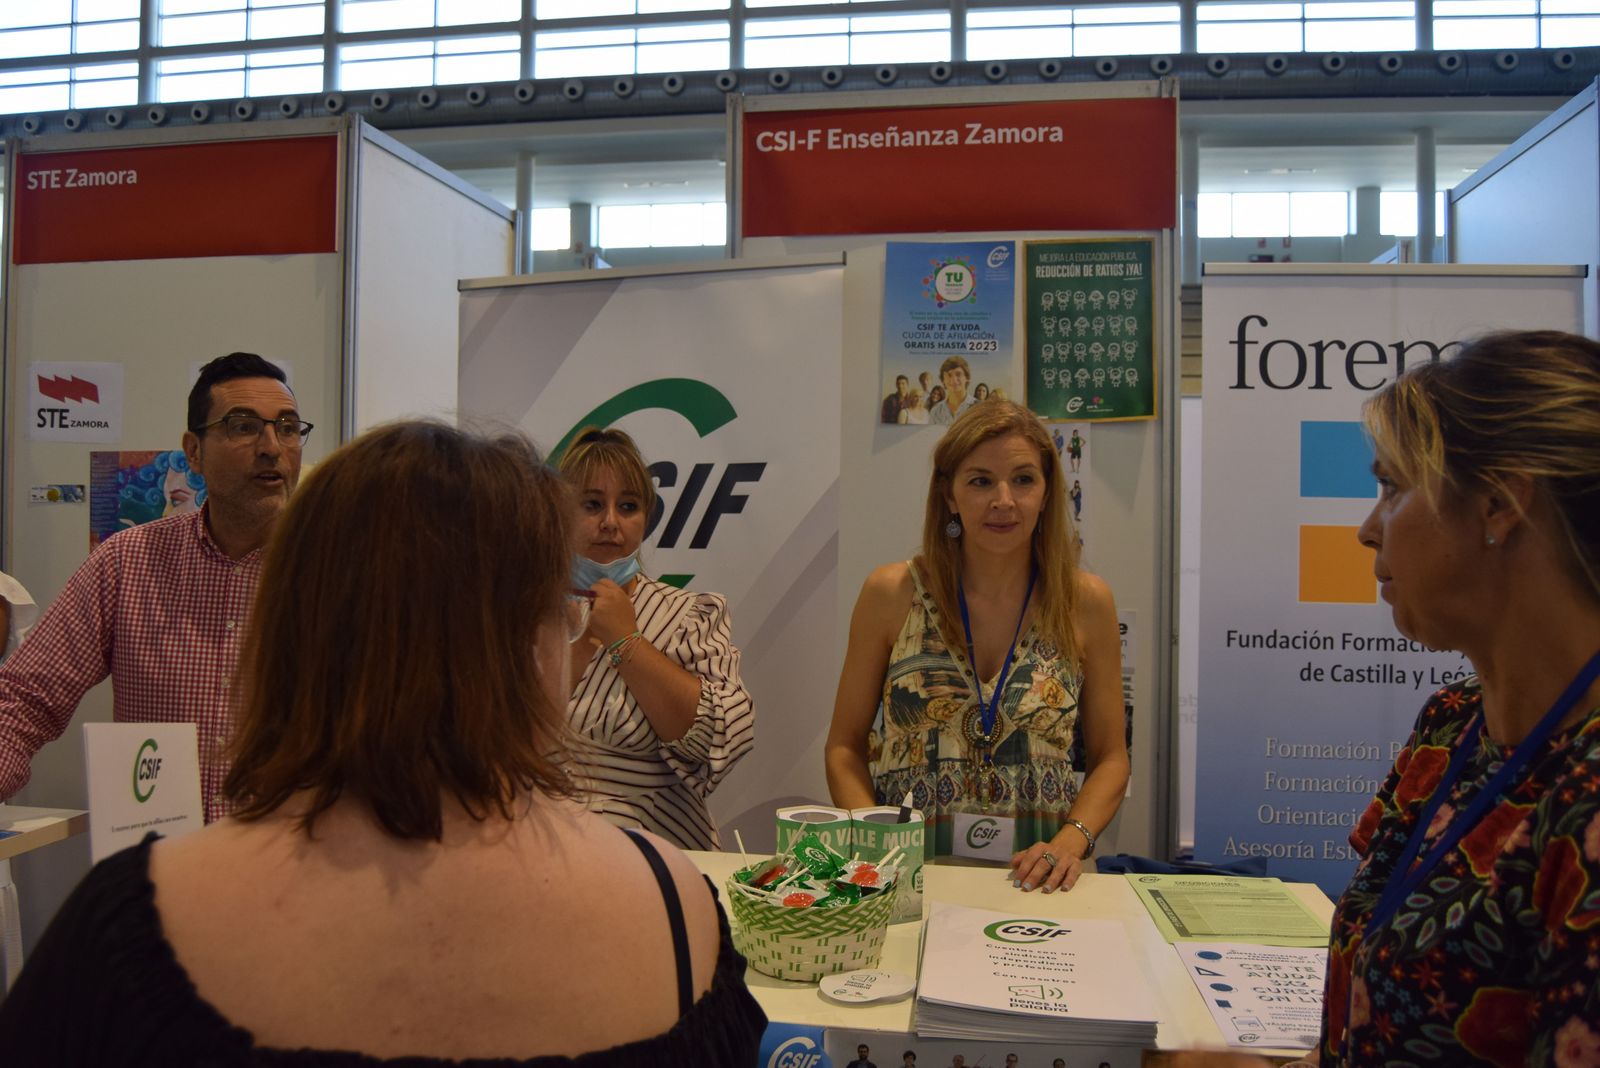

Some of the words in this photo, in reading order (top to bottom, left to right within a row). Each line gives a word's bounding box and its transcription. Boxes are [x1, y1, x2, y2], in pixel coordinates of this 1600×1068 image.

[756, 129, 821, 152] CSI-F
[828, 125, 959, 150] Enseñanza
[965, 122, 1063, 145] Zamora
[27, 170, 61, 190] STE
[65, 168, 137, 188] Zamora
[945, 272, 963, 282] TU
[1036, 263, 1081, 278] REDUCCIÓN
[1083, 265, 1093, 277] DE
[1095, 263, 1124, 277] RATIOS
[917, 323, 934, 331] CSIF
[938, 323, 947, 331] TE
[950, 323, 980, 331] AYUDA
[902, 332, 931, 340] CUOTA
[934, 332, 944, 340] DE
[947, 331, 995, 340] AFILIACIÓN
[904, 341, 935, 350] GRATIS
[938, 341, 966, 350] HASTA
[968, 341, 997, 351] 2023
[37, 408, 70, 428] STE
[71, 420, 109, 429] ZAMORA
[1227, 629, 1334, 650] Fundación
[1300, 662, 1324, 682] de
[1331, 664, 1406, 684] Castilla
[1413, 671, 1424, 690] y
[1265, 737, 1381, 760] Formación
[139, 758, 162, 780] CSIF
[1264, 771, 1379, 793] Formación
[1258, 804, 1361, 827] Orientaci
[836, 827, 876, 848] VALE
[973, 827, 1001, 841] CSIF
[1223, 836, 1315, 859] Asesoría
[1002, 925, 1072, 938] CSIF
[1005, 952, 1057, 960] sindicato
[1003, 963, 1073, 972] profesional
[1021, 976, 1076, 984] nosotros
[1010, 998, 1050, 1006] tienes
[1010, 1003, 1069, 1012] palabra
[778, 1051, 821, 1068] CSIF
